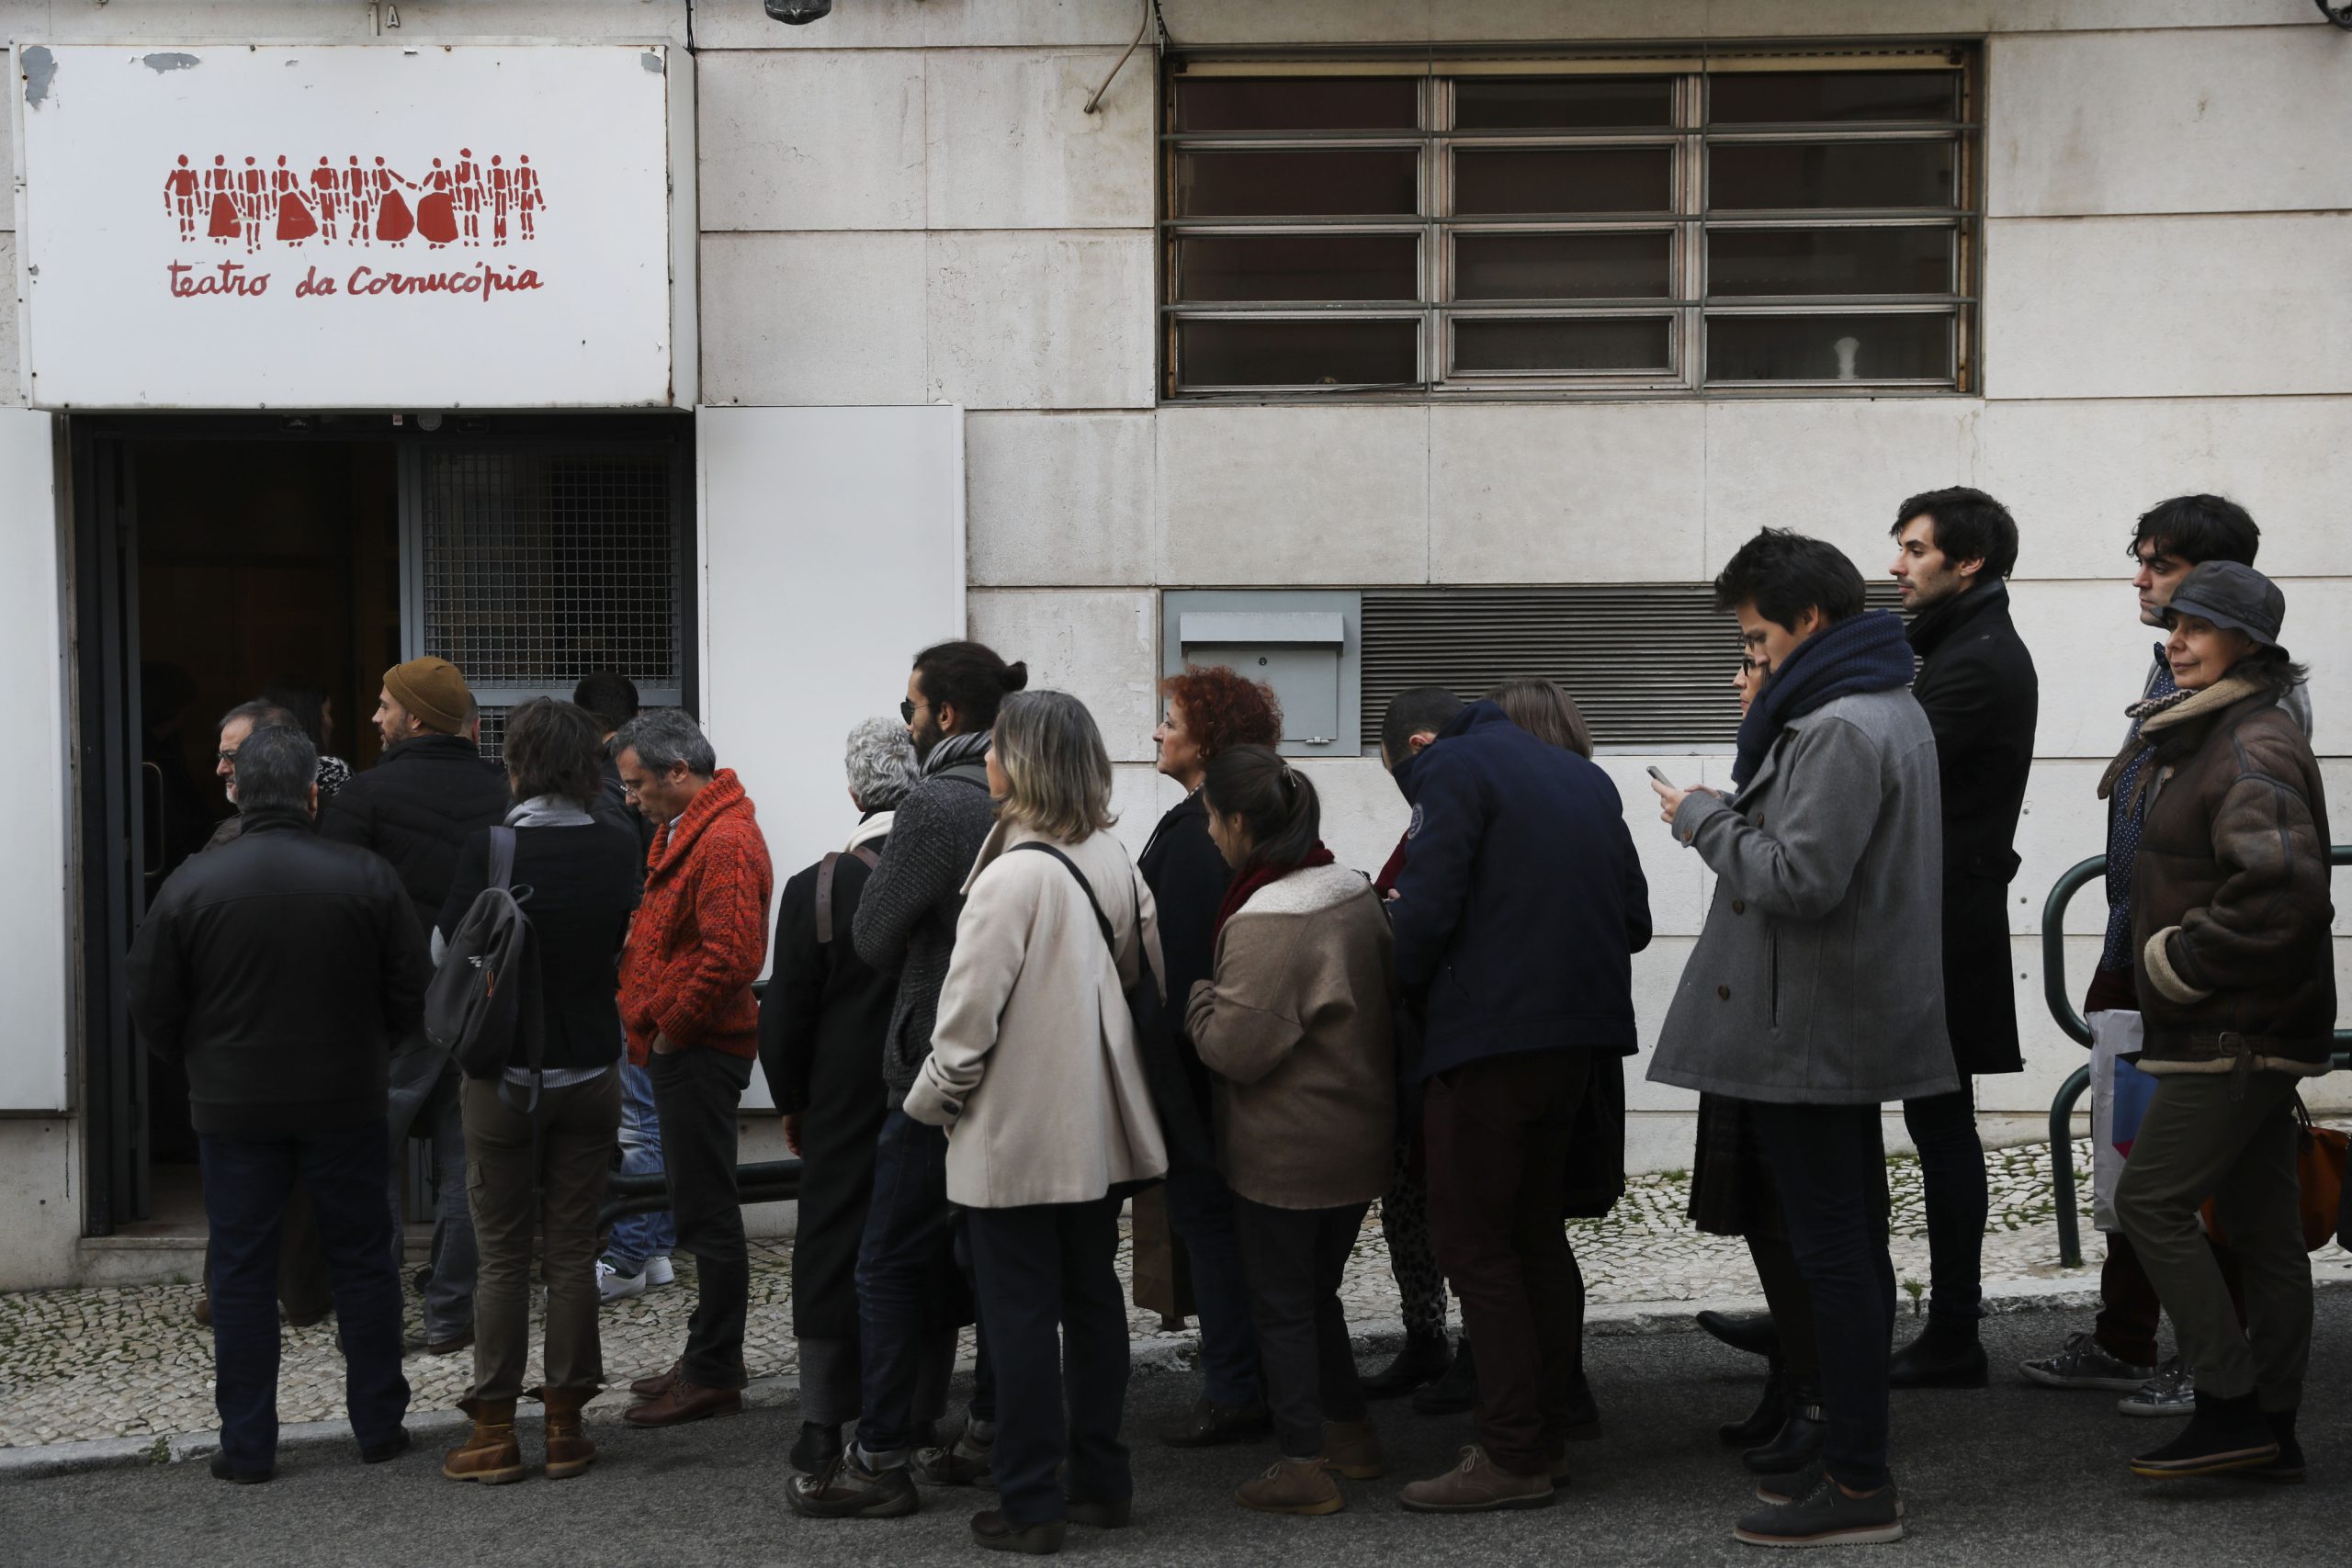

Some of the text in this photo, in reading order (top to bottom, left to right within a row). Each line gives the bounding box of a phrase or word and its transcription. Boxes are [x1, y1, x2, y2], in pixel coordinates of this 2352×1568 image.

[167, 259, 544, 302] teatro da Cornucópia
